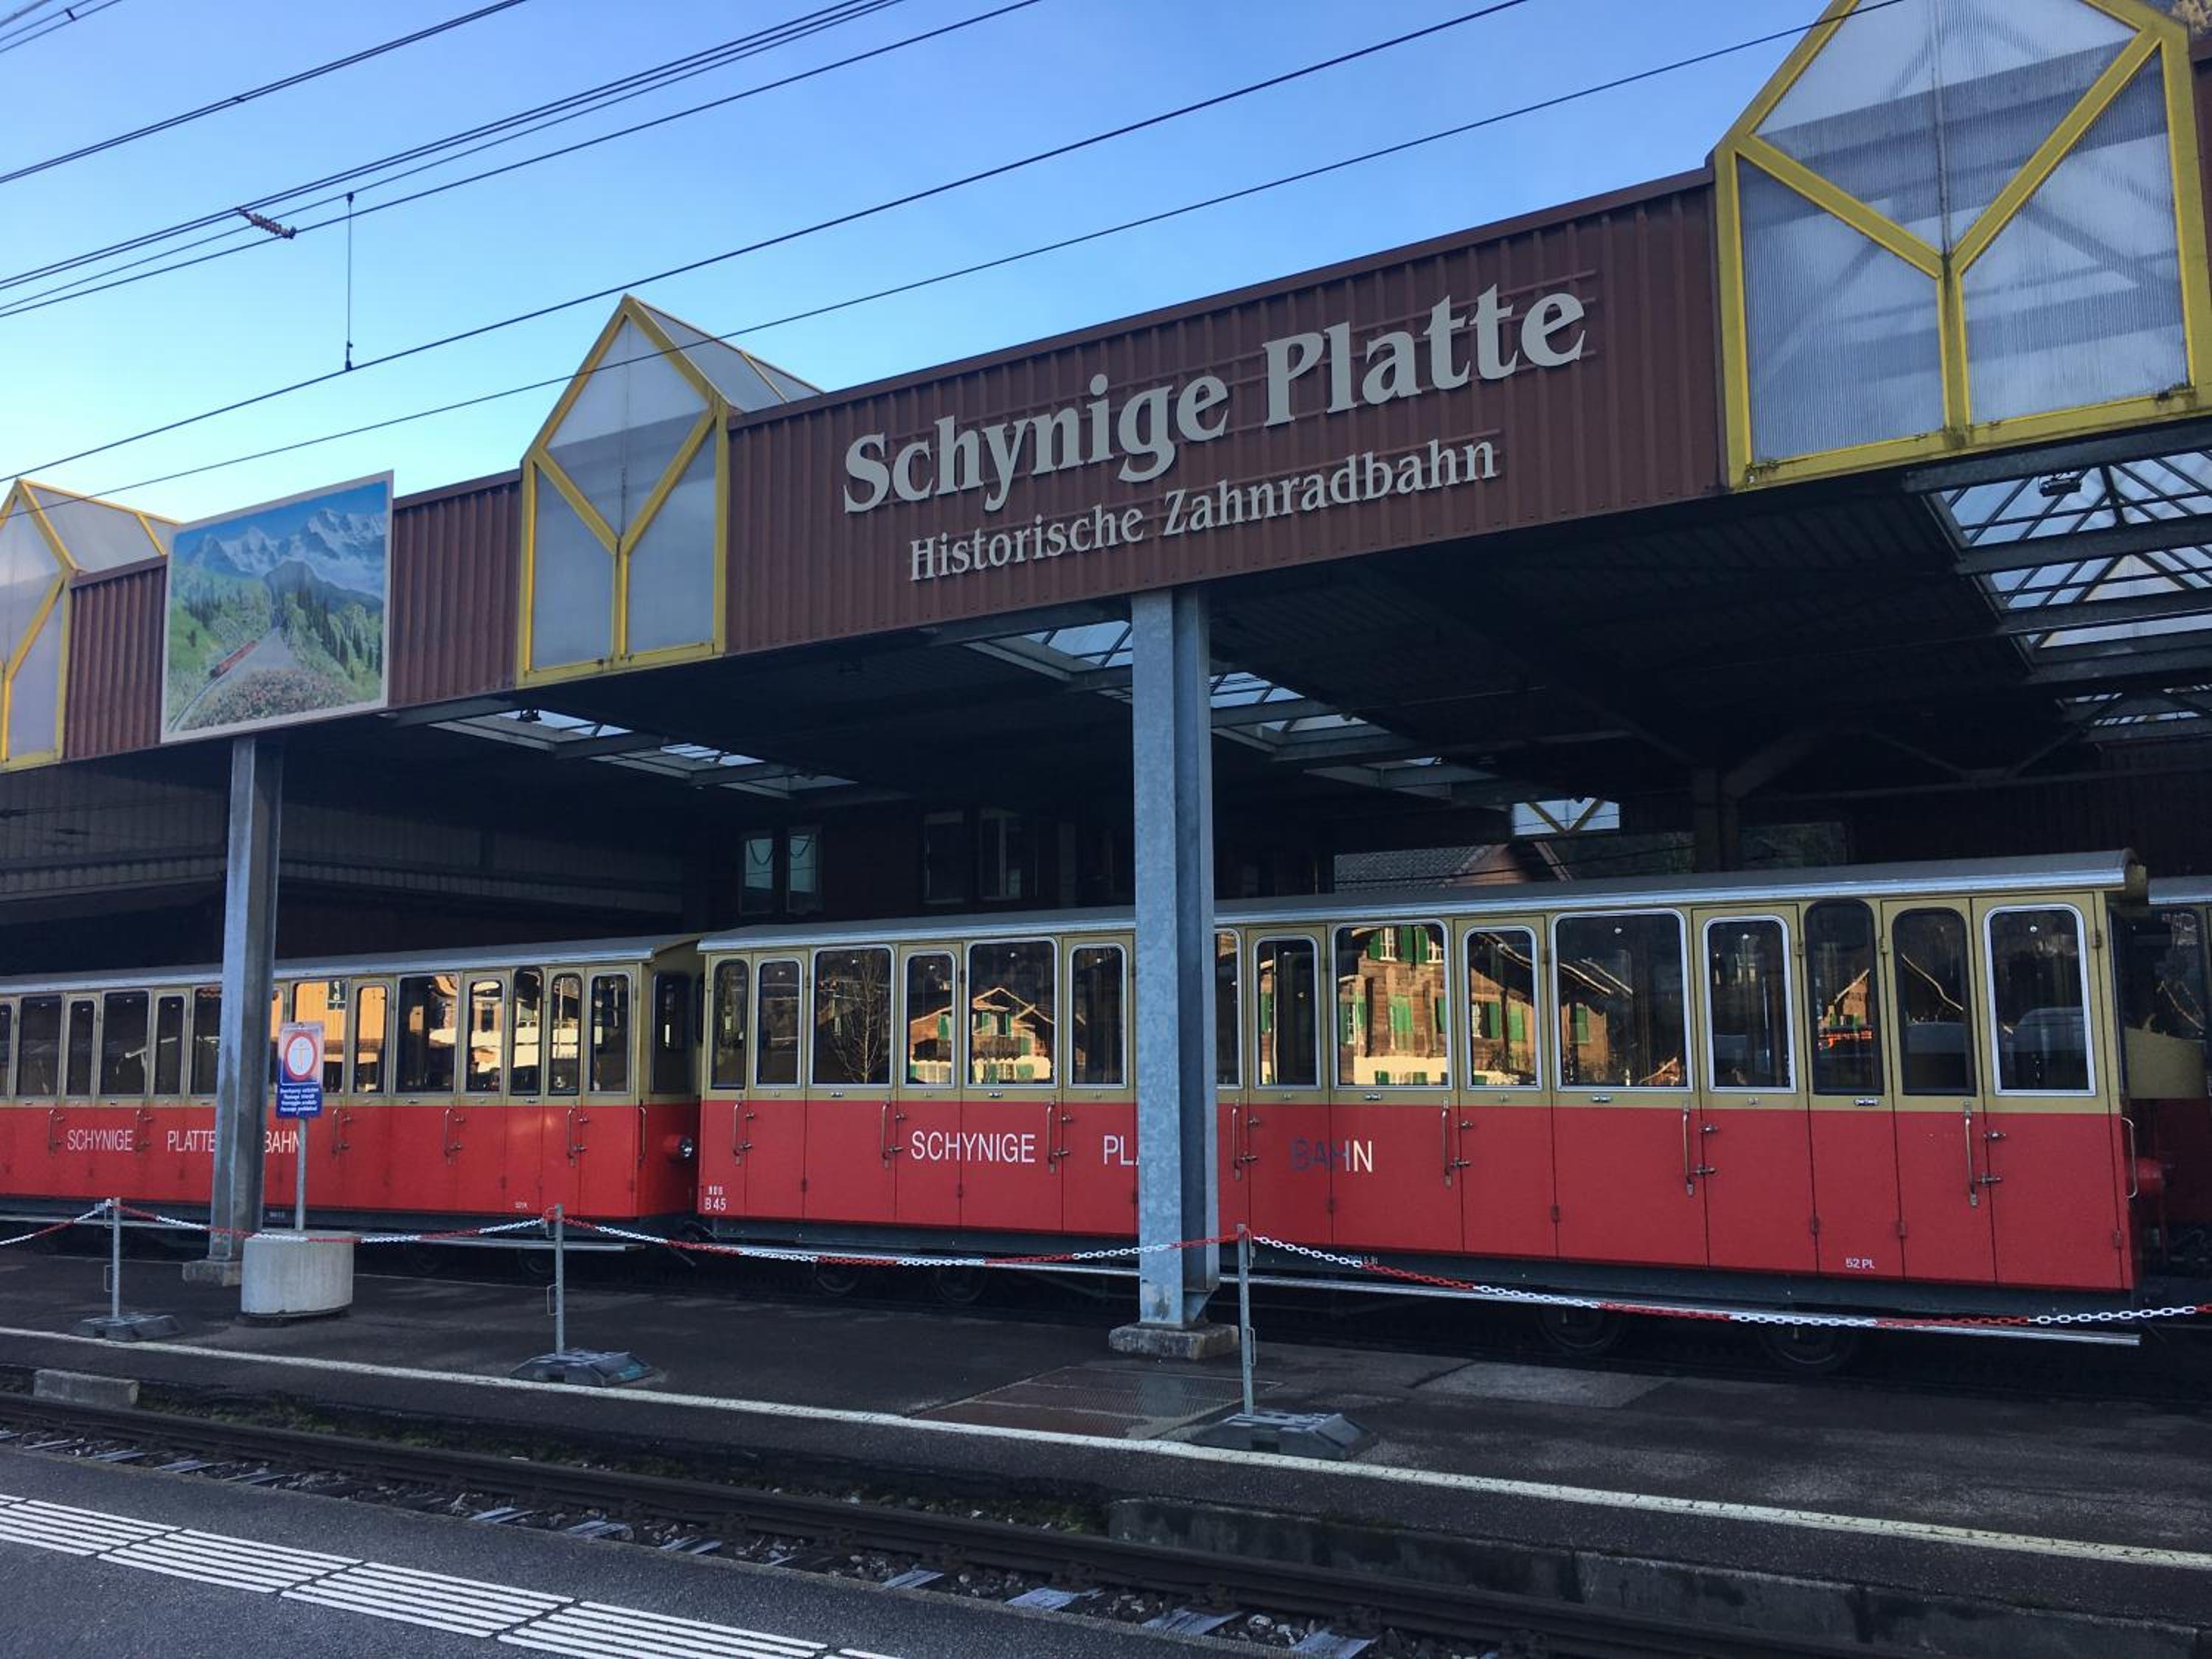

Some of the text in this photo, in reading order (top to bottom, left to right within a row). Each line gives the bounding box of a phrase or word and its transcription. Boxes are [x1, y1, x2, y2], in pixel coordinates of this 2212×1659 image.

[843, 282, 1587, 513] Schynige Platte
[909, 437, 1498, 582] Historische Zahnradbahn
[67, 1129, 133, 1152] SCHYNIGE
[167, 1130, 215, 1152] PLATTE
[911, 1130, 1036, 1164] SCHYNIGE
[1104, 1135, 1138, 1165] PL
